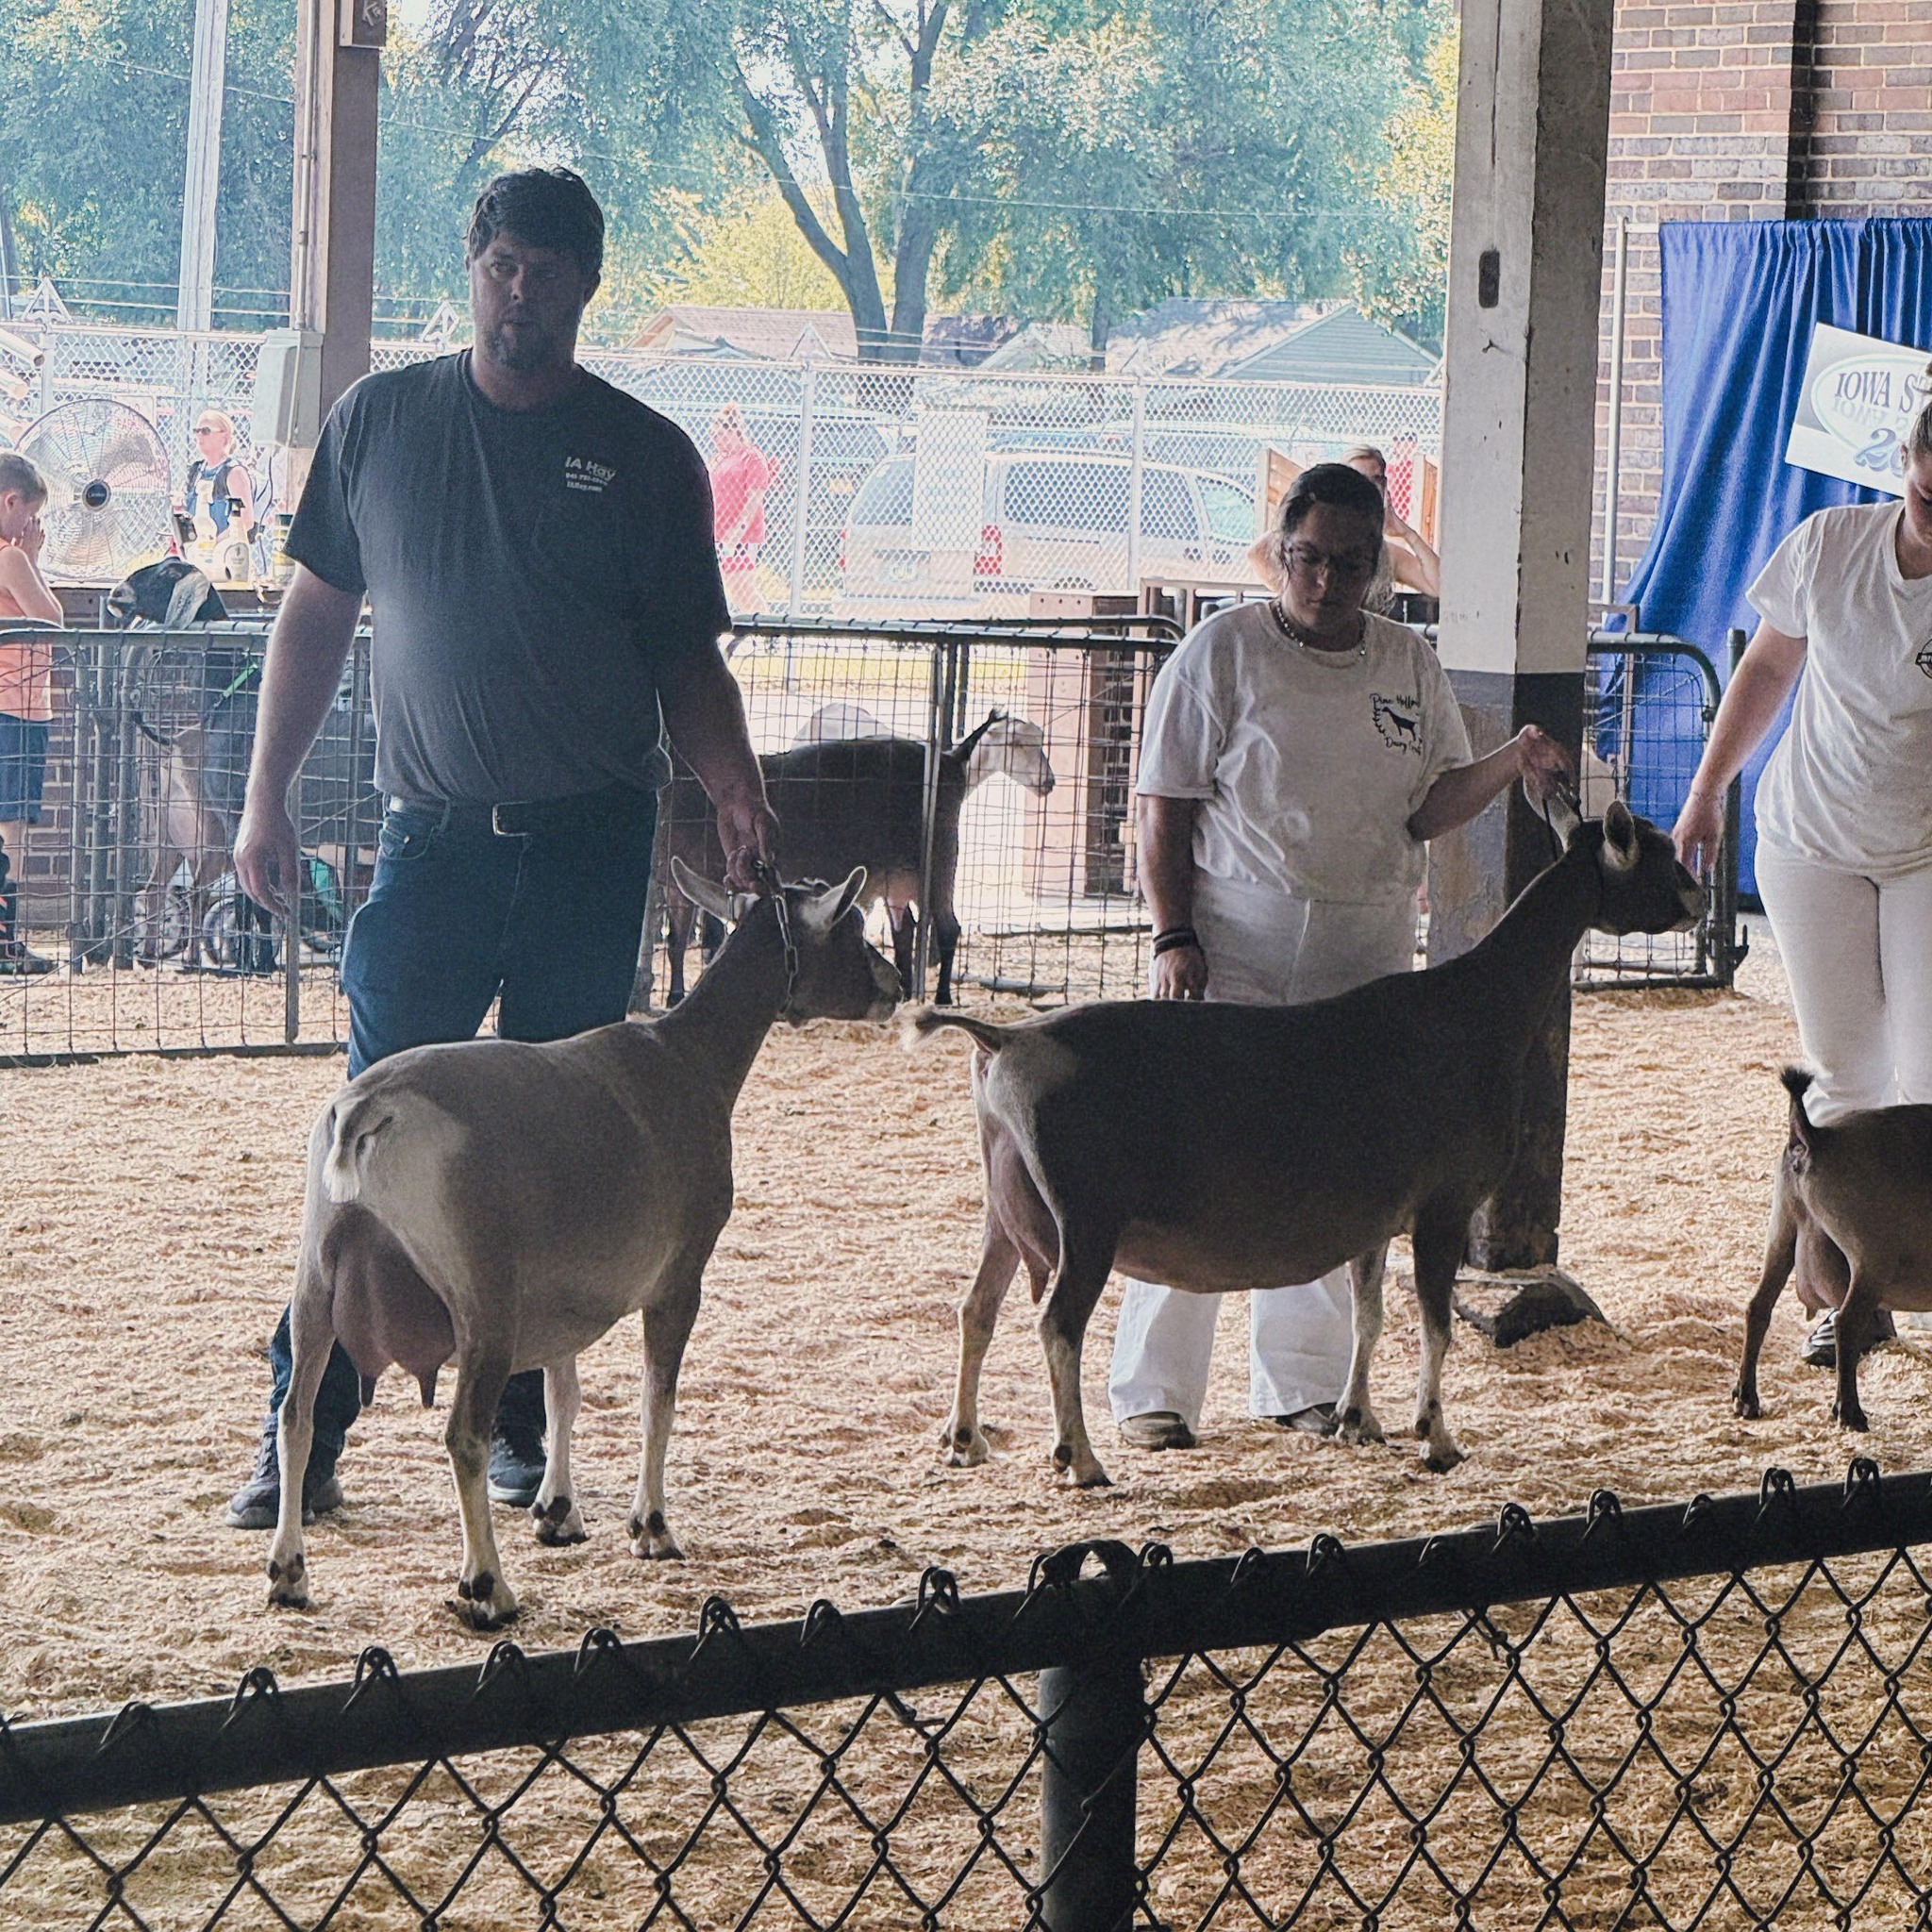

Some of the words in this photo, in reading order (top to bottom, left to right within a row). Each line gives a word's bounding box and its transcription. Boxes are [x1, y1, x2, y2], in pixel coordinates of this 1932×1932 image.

[1835, 372, 1890, 408] IOWA
[565, 457, 582, 470] IA
[585, 460, 617, 482] Hay
